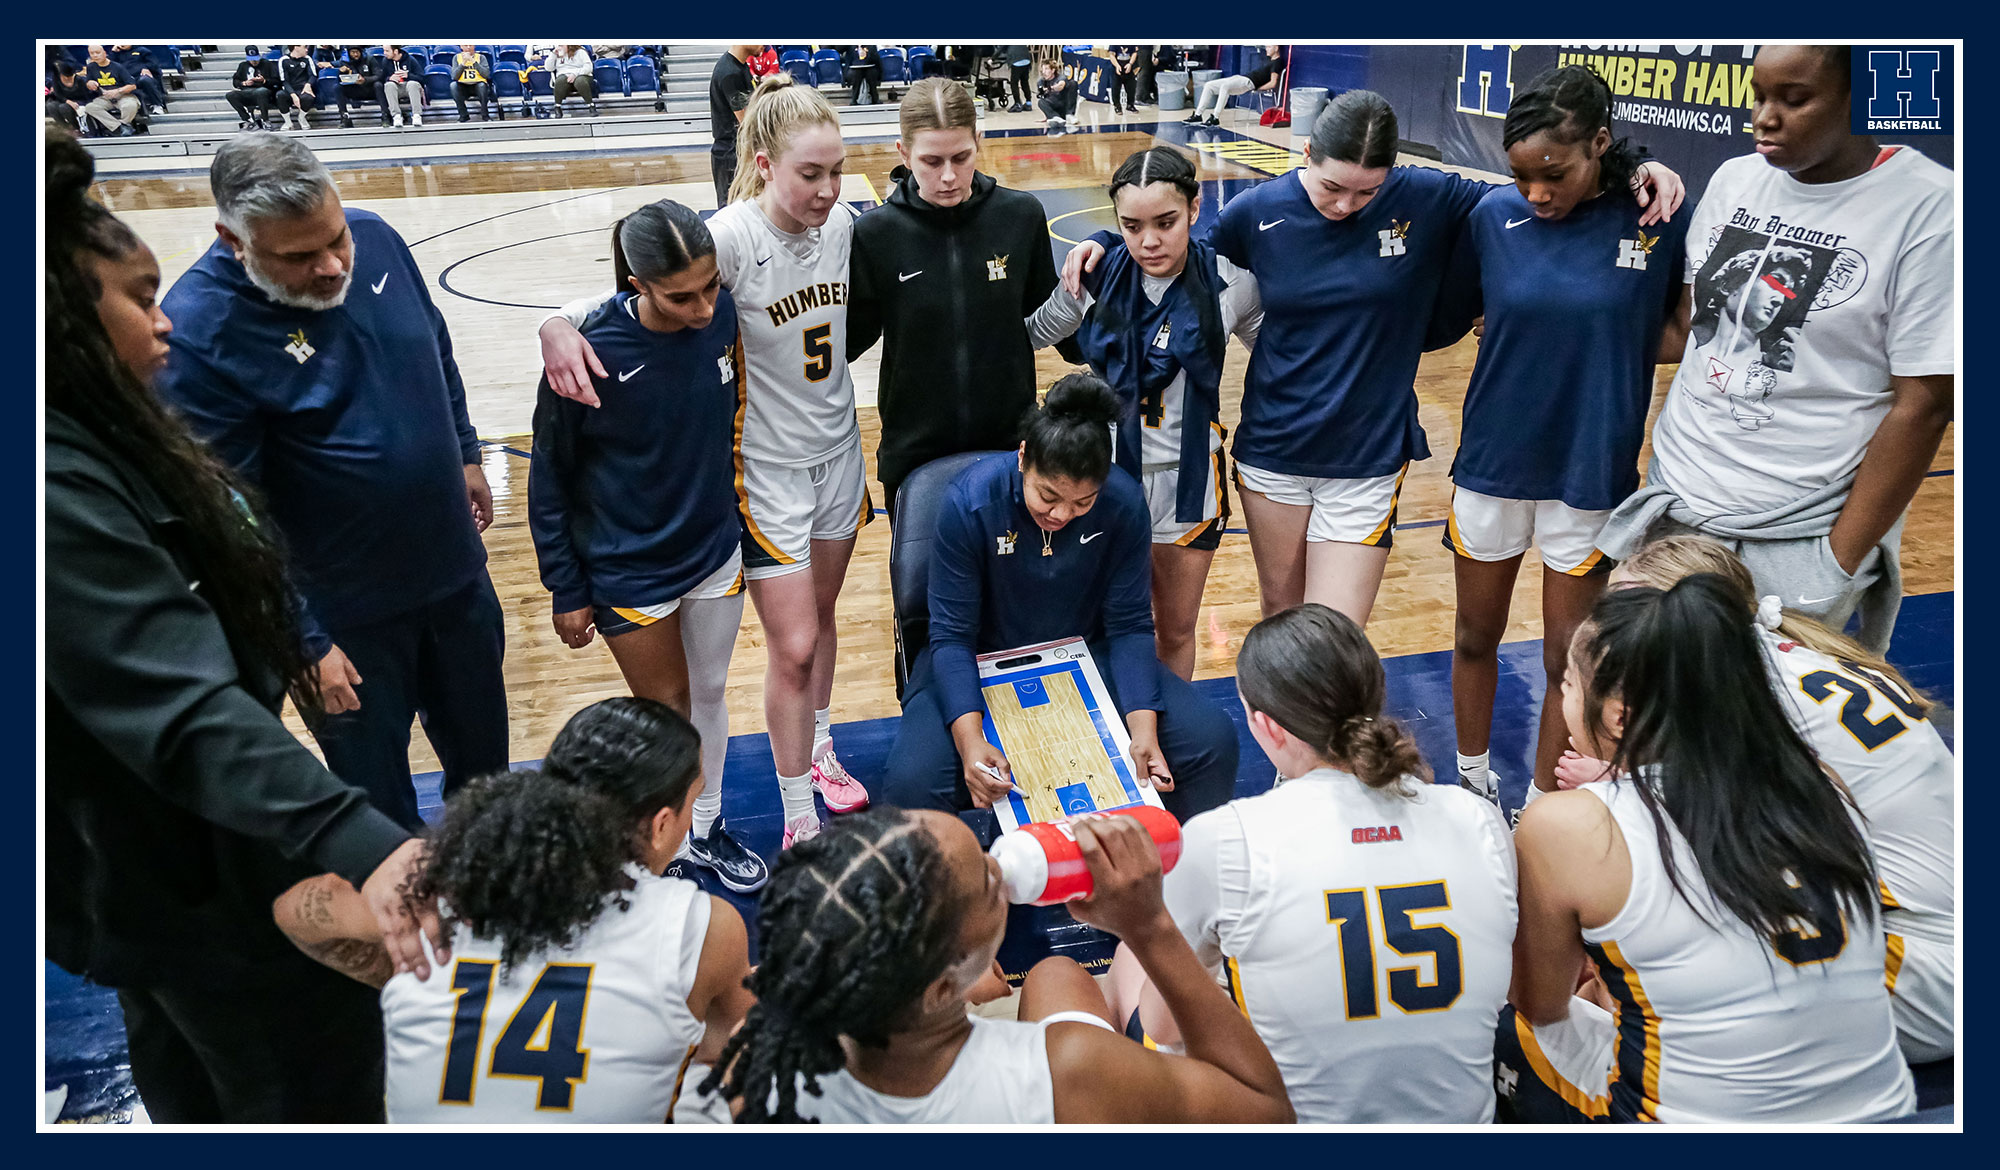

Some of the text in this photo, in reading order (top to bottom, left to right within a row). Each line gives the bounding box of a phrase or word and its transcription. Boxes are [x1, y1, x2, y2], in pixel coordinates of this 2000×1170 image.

[464, 70, 476, 79] 15
[1730, 207, 1847, 248] Day Dreamer
[803, 321, 832, 383] 5
[1352, 825, 1403, 844] OCAA
[1323, 878, 1465, 1022] 15
[438, 957, 597, 1113] 14
